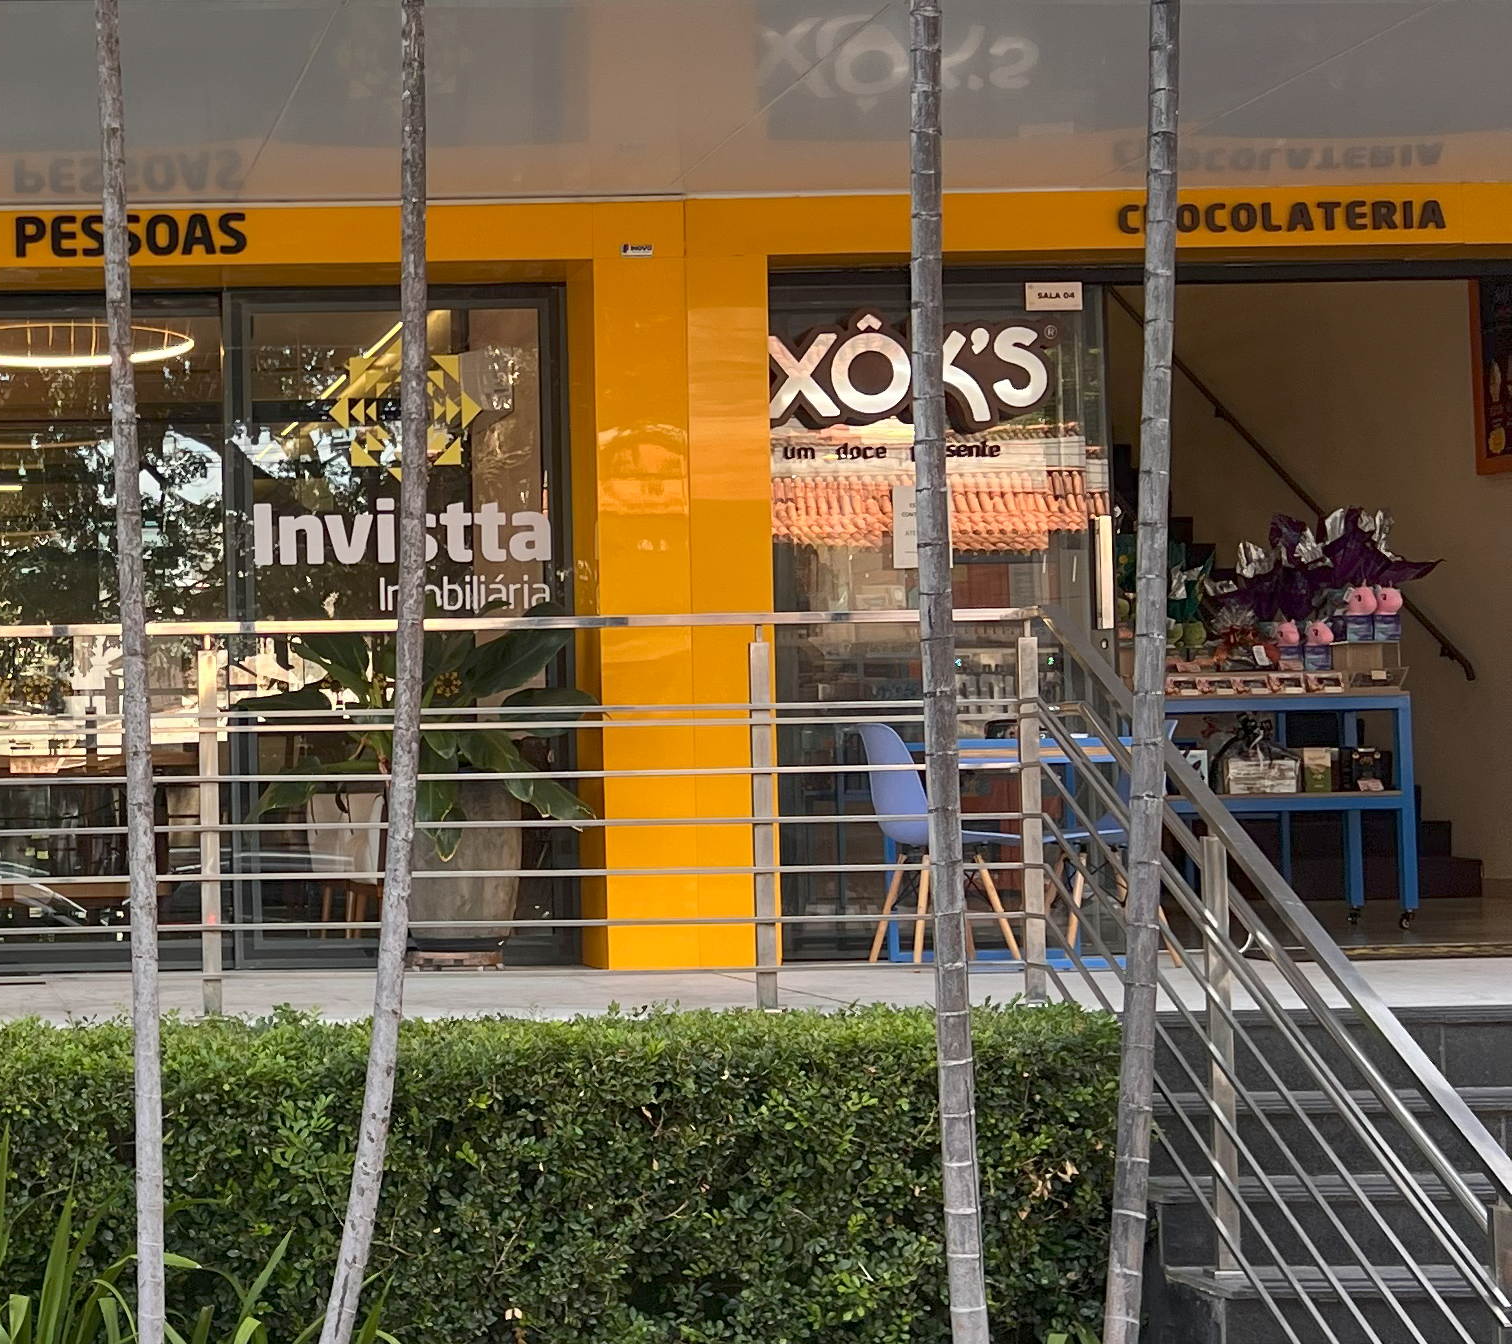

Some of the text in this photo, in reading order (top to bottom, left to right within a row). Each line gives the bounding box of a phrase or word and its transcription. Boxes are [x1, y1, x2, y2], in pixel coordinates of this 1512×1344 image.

[1118, 199, 1445, 234] COCOLATERIA
[769, 313, 1048, 422] XÔK'S
[782, 440, 1001, 462] um doce sente
